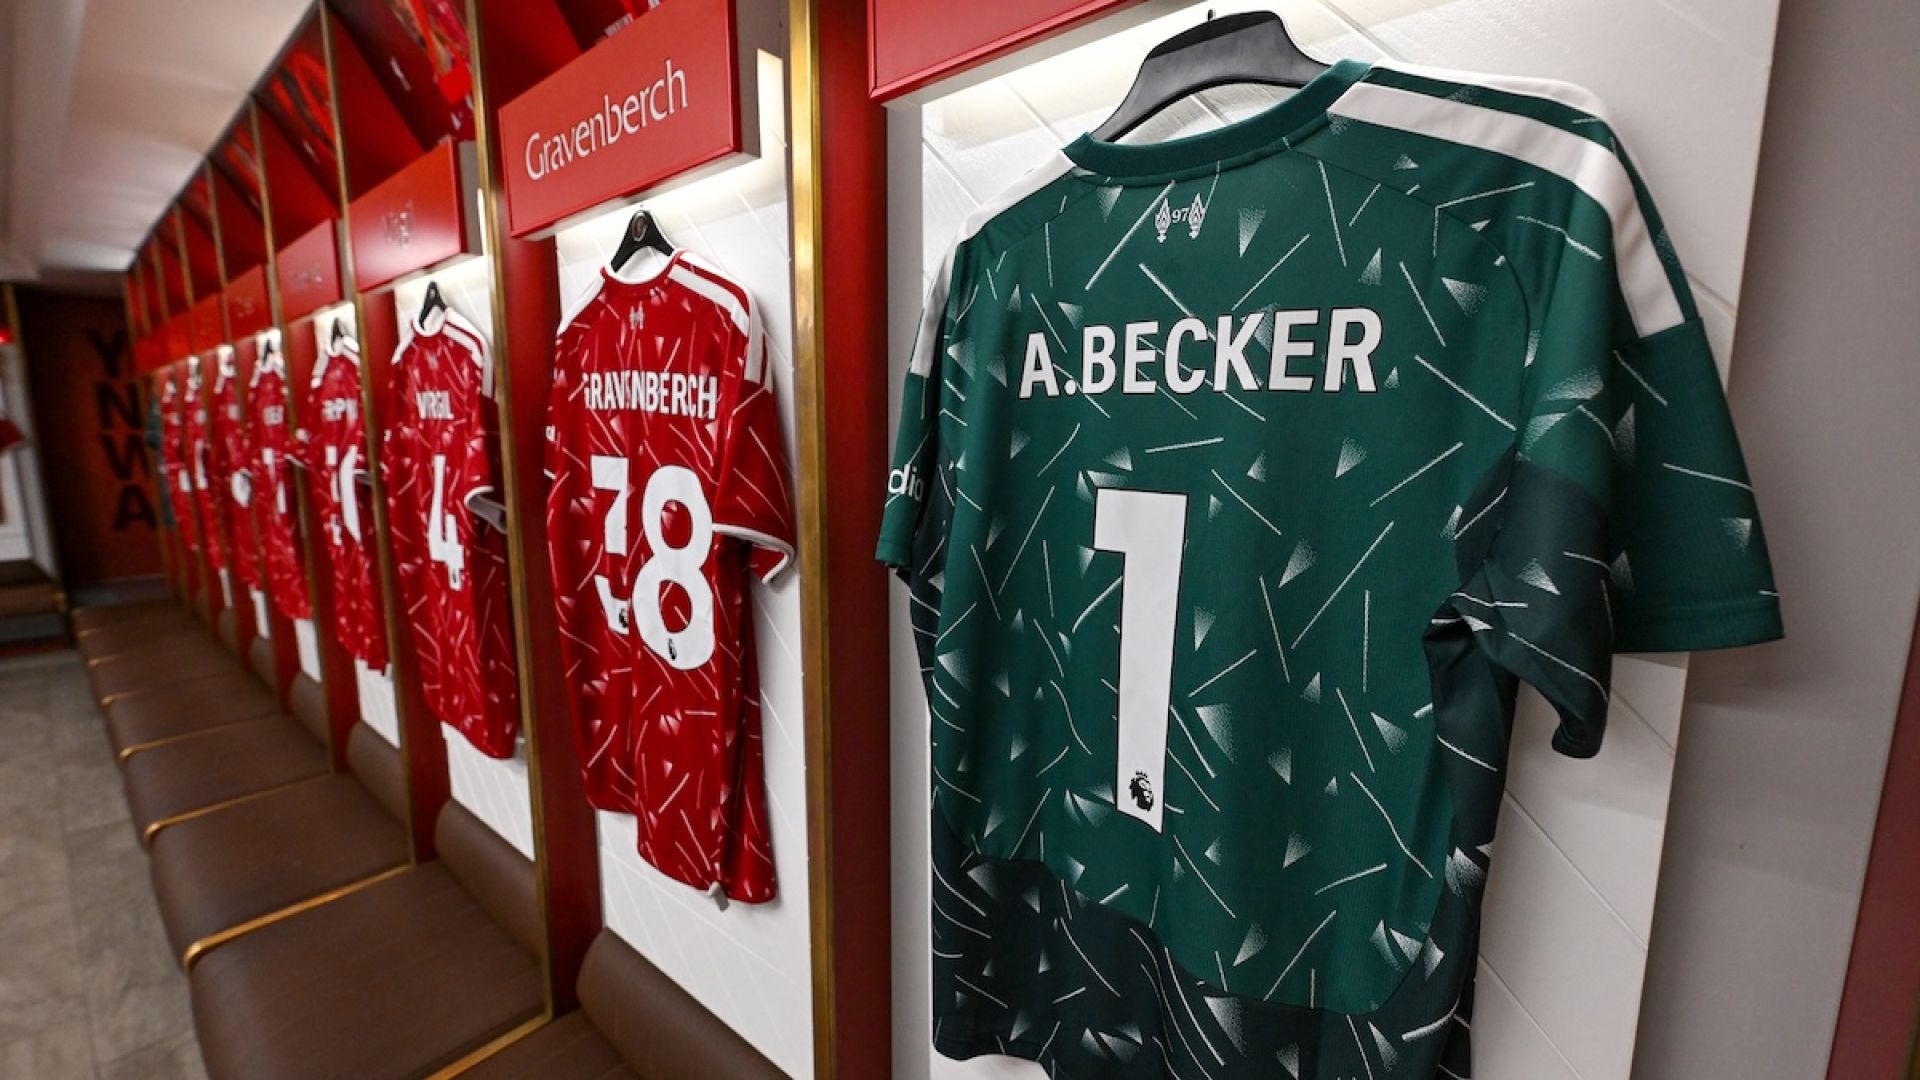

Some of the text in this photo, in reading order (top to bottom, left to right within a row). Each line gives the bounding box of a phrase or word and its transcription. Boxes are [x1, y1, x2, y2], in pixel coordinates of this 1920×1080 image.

[525, 58, 688, 181] Gravenberch
[1172, 209, 1188, 224] 97
[1018, 306, 1384, 400] A.BECKER
[428, 453, 465, 592] 4
[1093, 487, 1189, 834] 1
